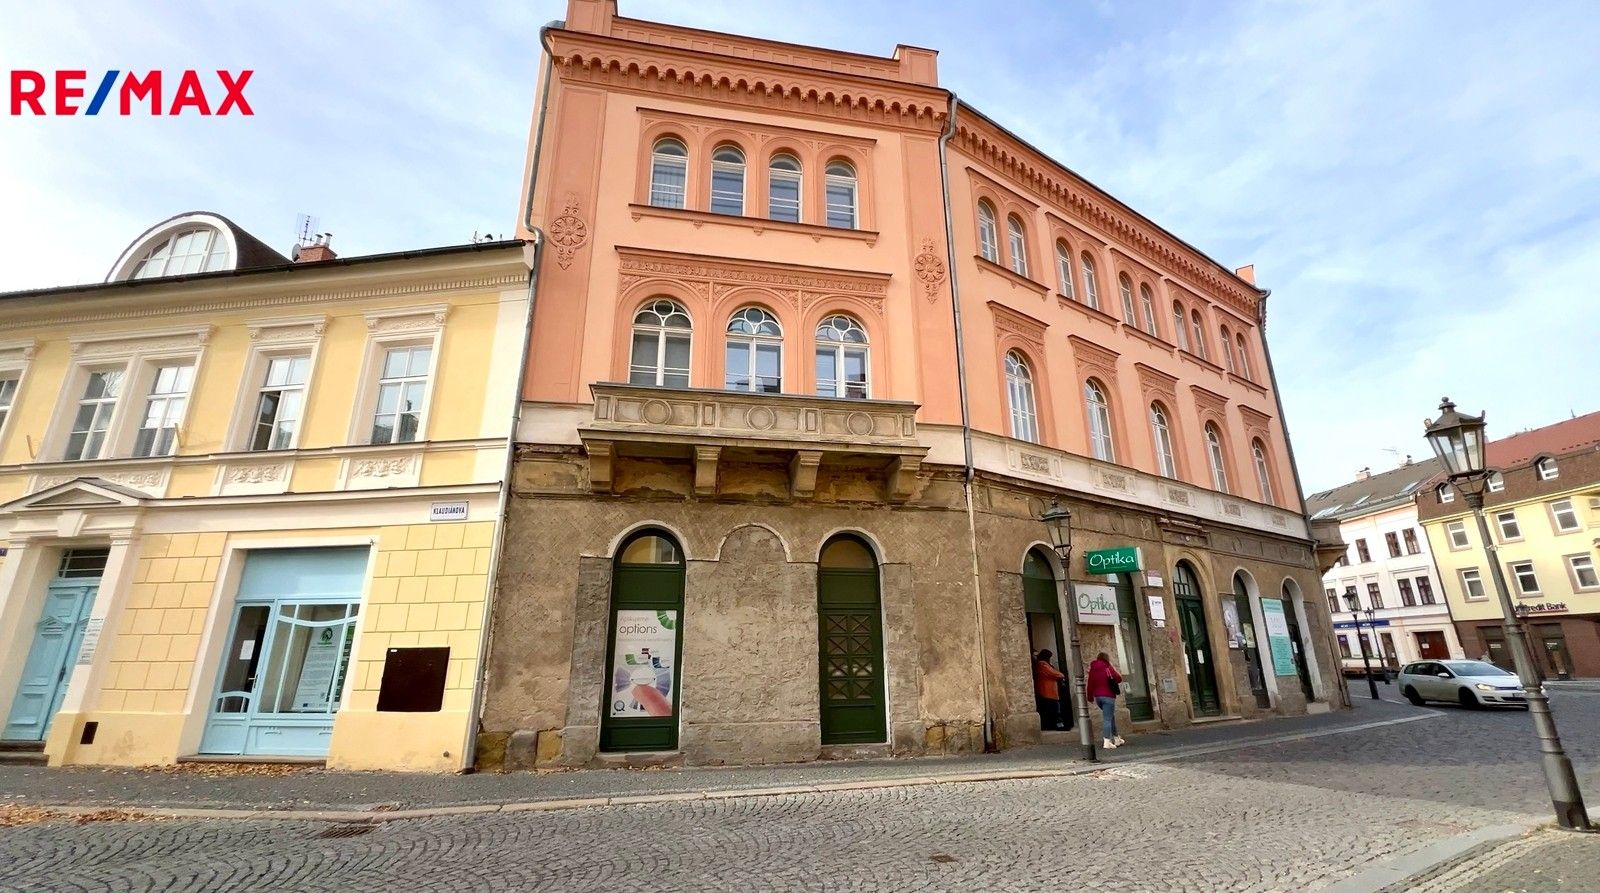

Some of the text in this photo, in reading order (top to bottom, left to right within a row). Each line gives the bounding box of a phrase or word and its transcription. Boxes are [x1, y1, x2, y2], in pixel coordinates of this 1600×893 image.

[1089, 551, 1135, 570] Optika
[1078, 593, 1116, 614] Optika
[1546, 602, 1566, 611] Bank
[619, 623, 658, 636] options
